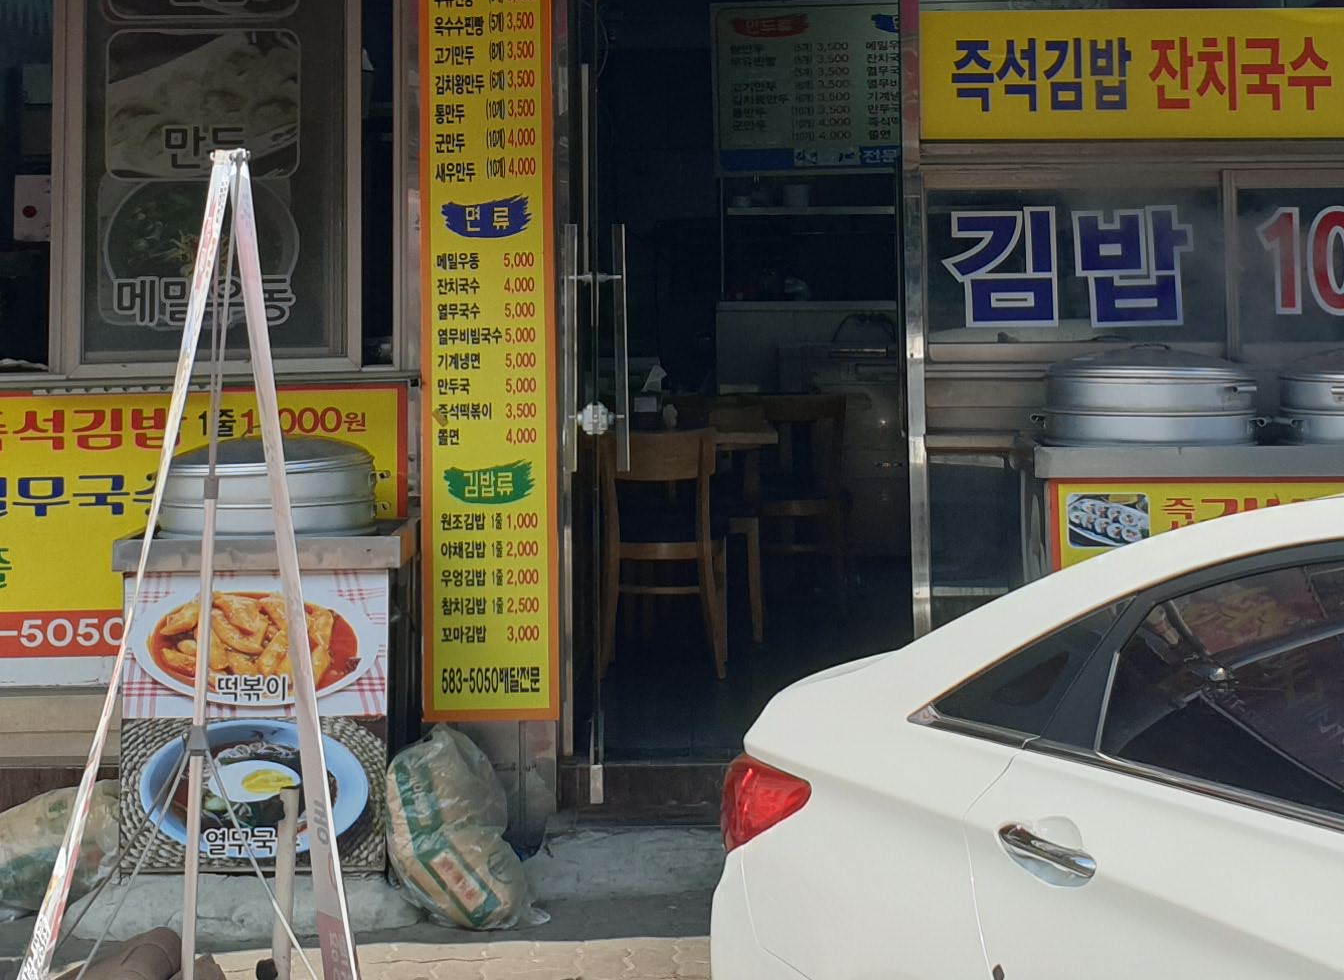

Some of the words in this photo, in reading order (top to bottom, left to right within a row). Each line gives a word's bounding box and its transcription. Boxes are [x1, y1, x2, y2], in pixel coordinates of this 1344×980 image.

[507, 12, 534, 30] 3,500
[434, 45, 475, 65] 고기만두
[507, 41, 534, 59] 3,500
[435, 74, 484, 94] 김치왕만두
[508, 70, 535, 88] 3,500
[952, 37, 1131, 112] 즉석김밥
[1149, 36, 1333, 112] 잔치국수
[434, 103, 464, 124] 통만두
[508, 100, 535, 118] 3,500
[435, 133, 465, 154] 군만두
[508, 128, 536, 147] 4,000
[435, 161, 476, 182] 새우만두
[508, 157, 536, 176] 4,000
[436, 252, 480, 270] 메밀우동
[503, 252, 534, 269] 5,000
[946, 207, 1194, 326] 김밥
[437, 277, 480, 295] 잔치국수
[504, 277, 535, 294] 4,000
[437, 303, 480, 321] 열무국수
[504, 302, 535, 319] 5,000
[437, 327, 502, 346] 열무비빔국수
[505, 327, 536, 344] 5,000
[437, 352, 481, 371] 기계냉면
[505, 352, 536, 369] 5,000
[437, 378, 471, 396] 만두국
[505, 378, 536, 395] 5,000
[506, 402, 536, 419] 3,500
[506, 428, 537, 444] 4,000
[464, 470, 514, 498] 김밥류
[440, 513, 486, 531] 원조김밥
[506, 513, 538, 529] 1,000
[440, 540, 486, 560] 야채김밥
[506, 540, 539, 557] 2,000
[441, 569, 486, 588] 우엉김밥
[507, 569, 539, 586] 2,000
[441, 597, 487, 616] 참치김밥
[507, 597, 540, 614] 2,500
[441, 626, 487, 644] 꼬마김밥
[507, 626, 540, 642] 3,000
[218, 676, 286, 702] 떡볶이
[205, 830, 301, 856] 열무국
